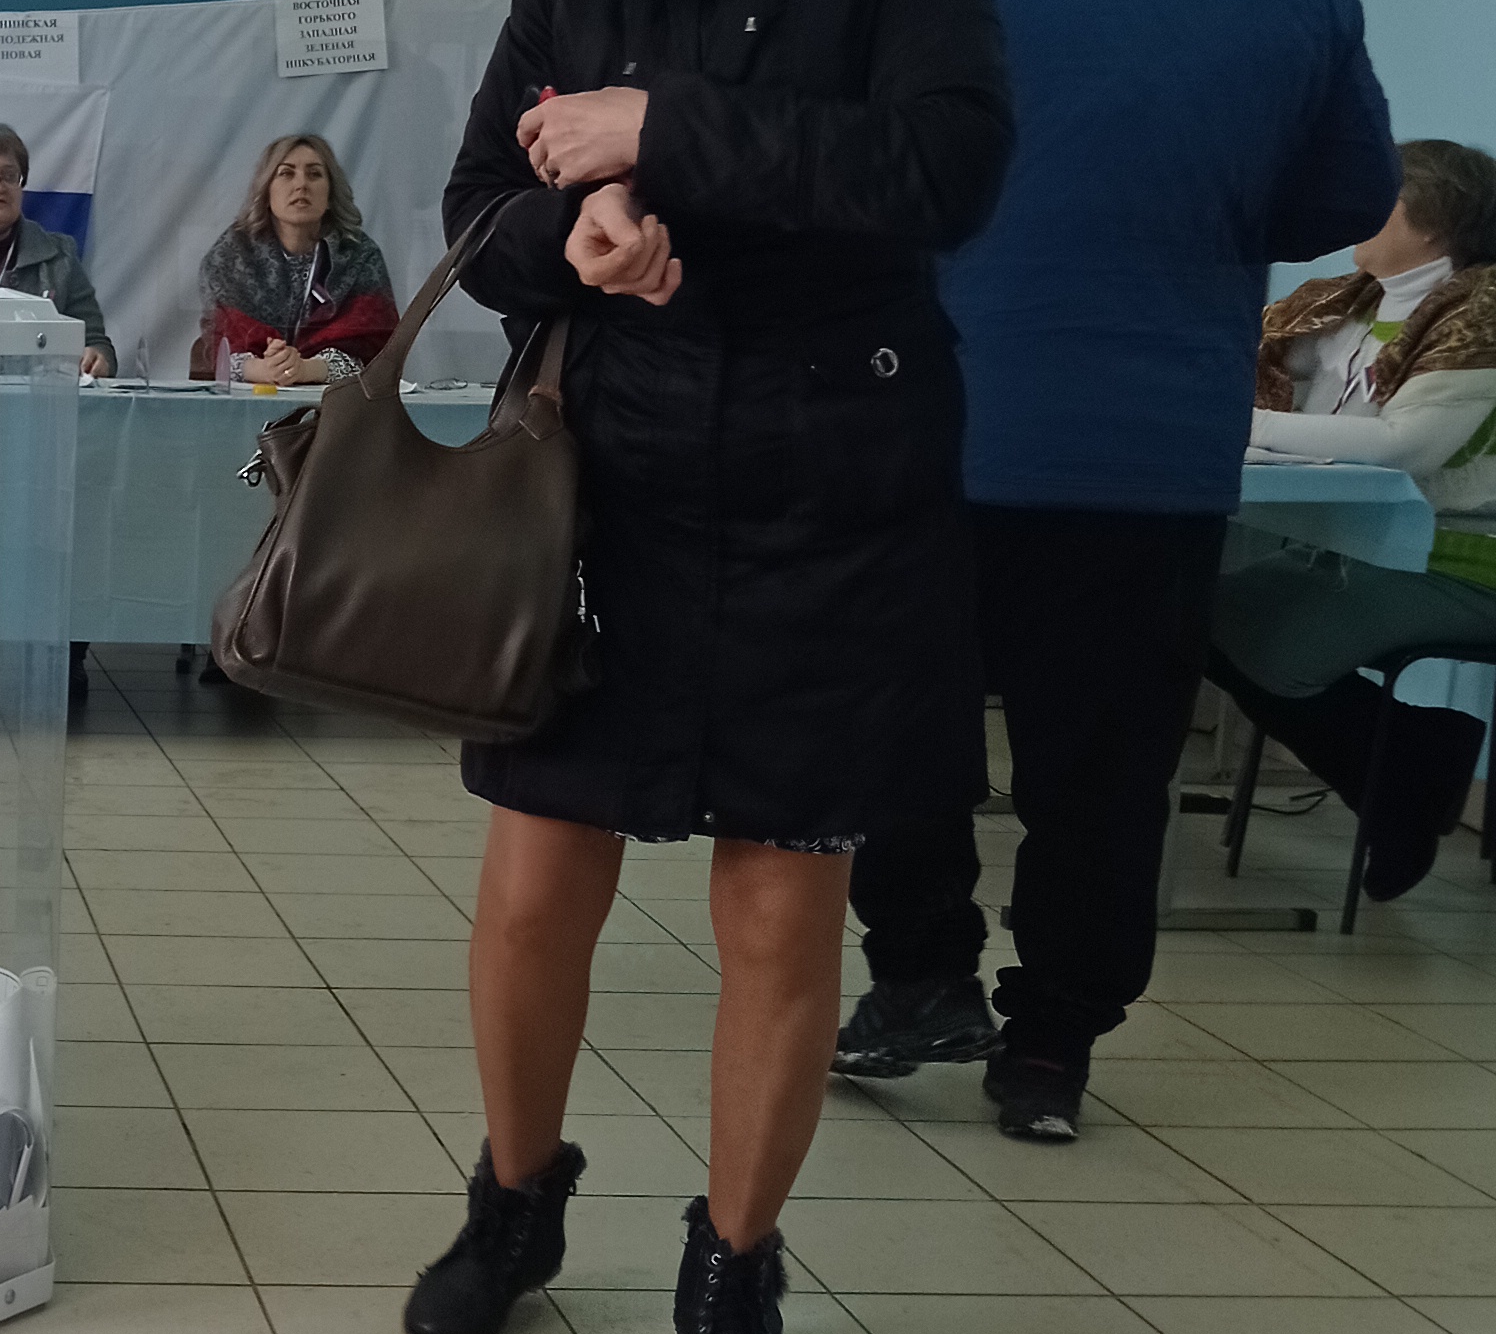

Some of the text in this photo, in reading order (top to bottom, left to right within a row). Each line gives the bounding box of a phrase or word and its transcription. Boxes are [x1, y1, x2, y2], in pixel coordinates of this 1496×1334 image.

[298, 11, 356, 25] ГОРЬКОГО
[300, 25, 357, 39] ЗАПАДНАЯ
[306, 40, 354, 52] ЗЕЛЕНАЯ
[1, 49, 41, 60] НОВАЯ
[286, 52, 376, 69] ИНКУБАТОРНАЯ
